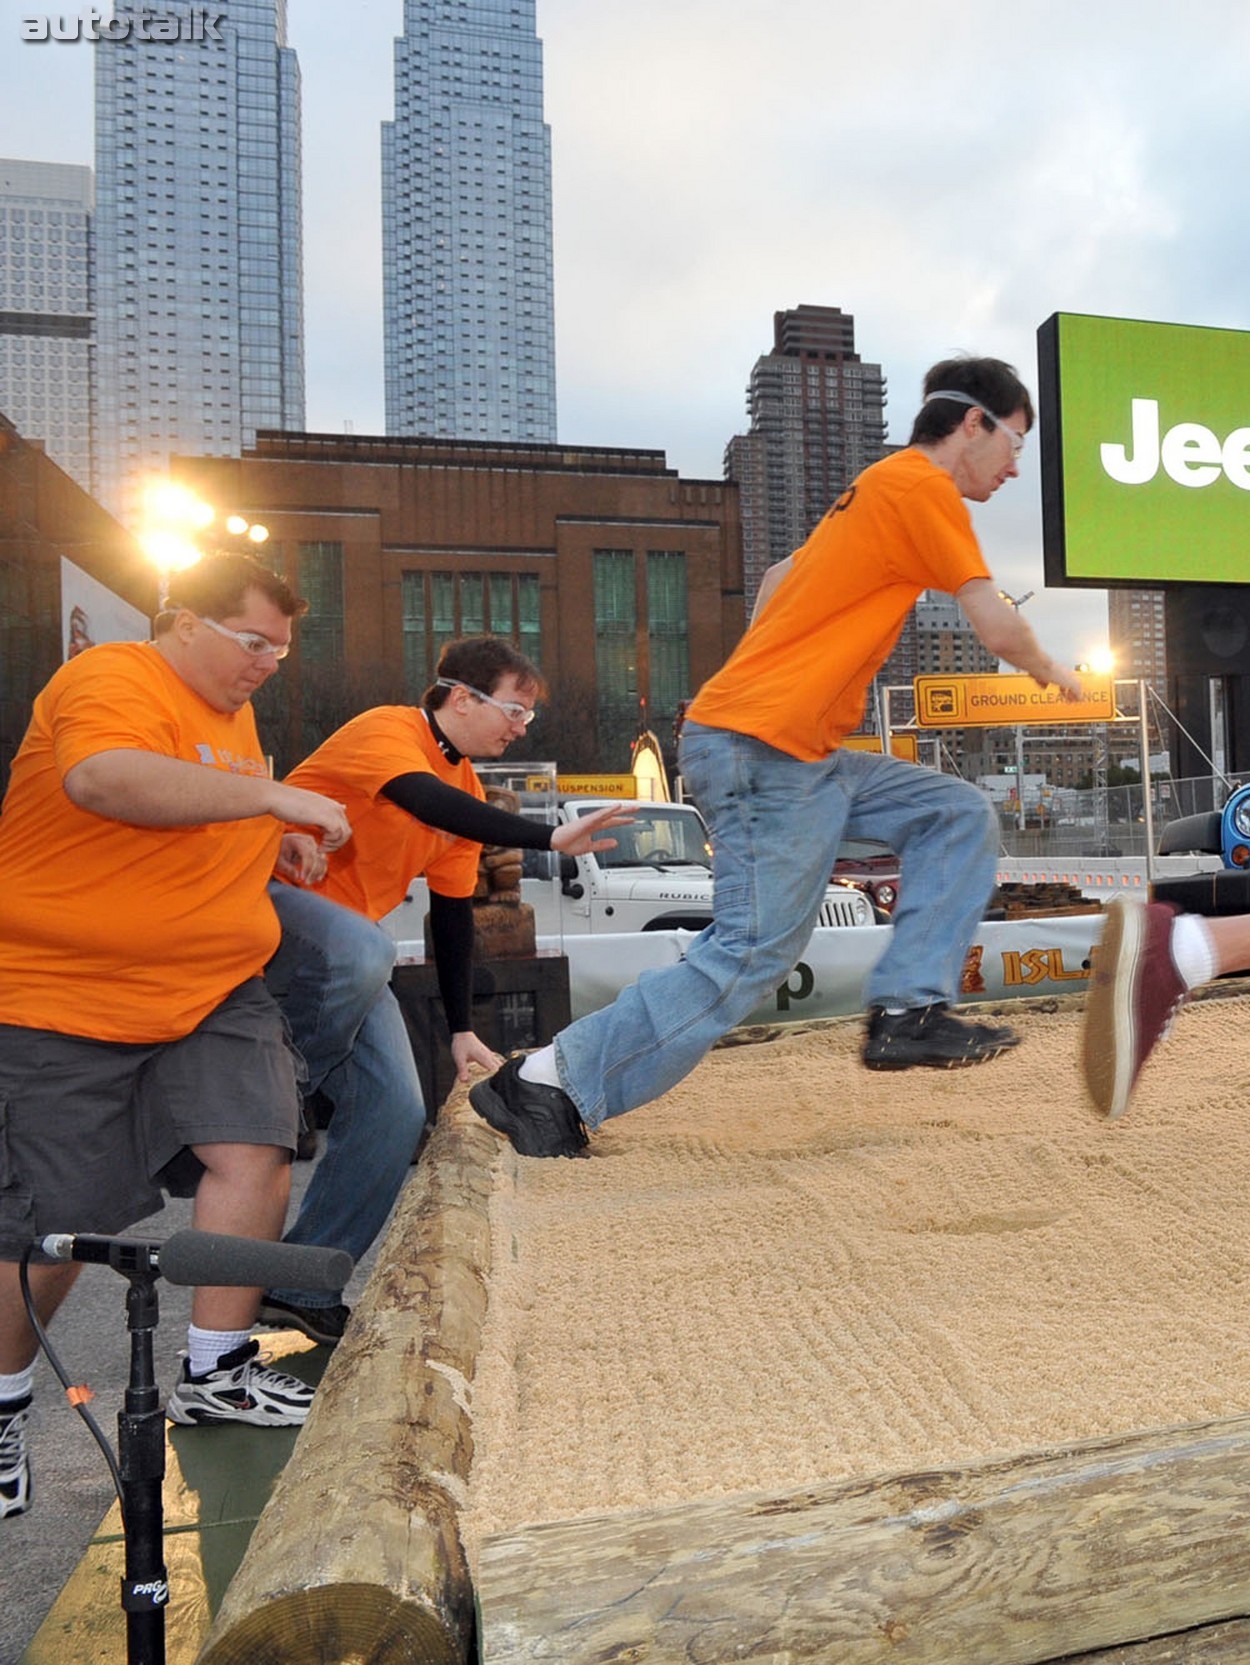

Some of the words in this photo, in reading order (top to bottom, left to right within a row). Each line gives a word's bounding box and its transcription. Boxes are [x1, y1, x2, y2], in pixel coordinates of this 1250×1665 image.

[970, 694, 1027, 707] GROUND
[1030, 690, 1107, 705] CLEANCE
[659, 892, 710, 901] RUBIC
[1001, 948, 1097, 985] ISL
[132, 1580, 162, 1595] PRG
